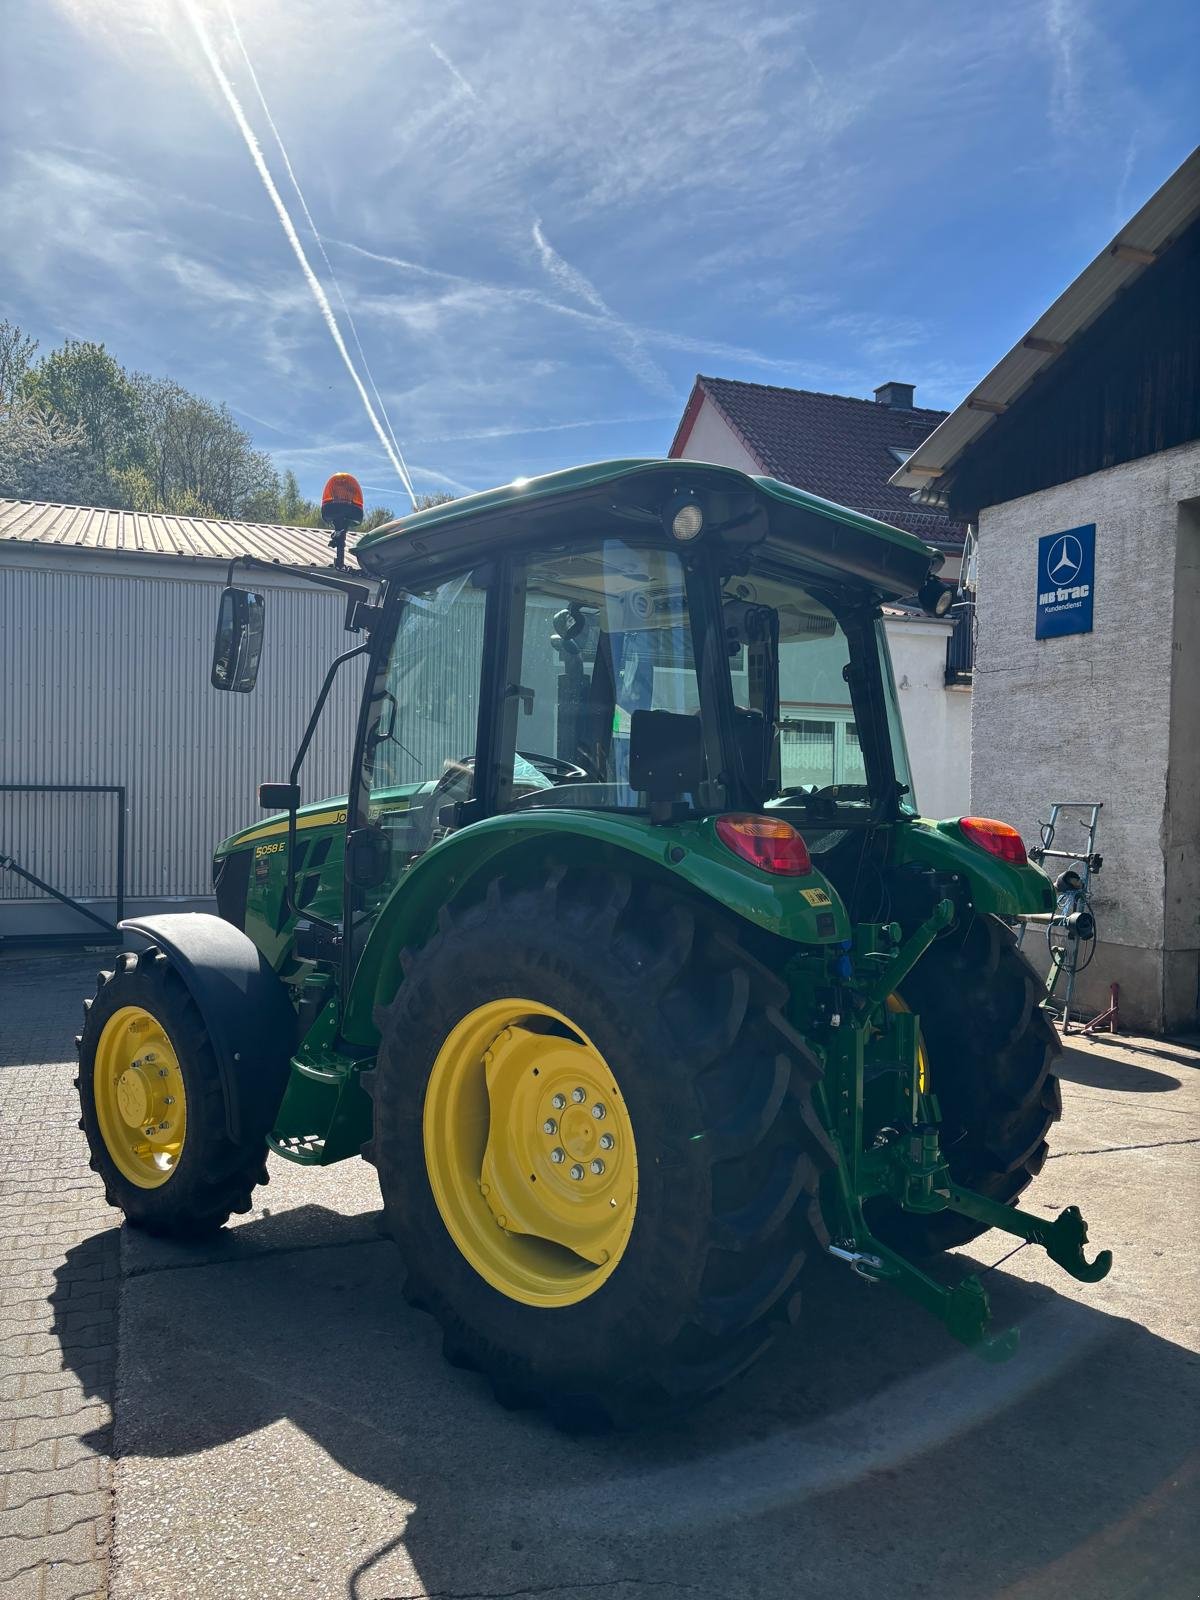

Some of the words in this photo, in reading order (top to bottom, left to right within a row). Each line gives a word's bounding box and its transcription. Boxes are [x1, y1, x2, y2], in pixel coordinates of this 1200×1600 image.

[1039, 592, 1056, 605] MB
[1057, 585, 1089, 601] trac
[1045, 602, 1082, 613] Kundendienst
[332, 812, 347, 823] JO
